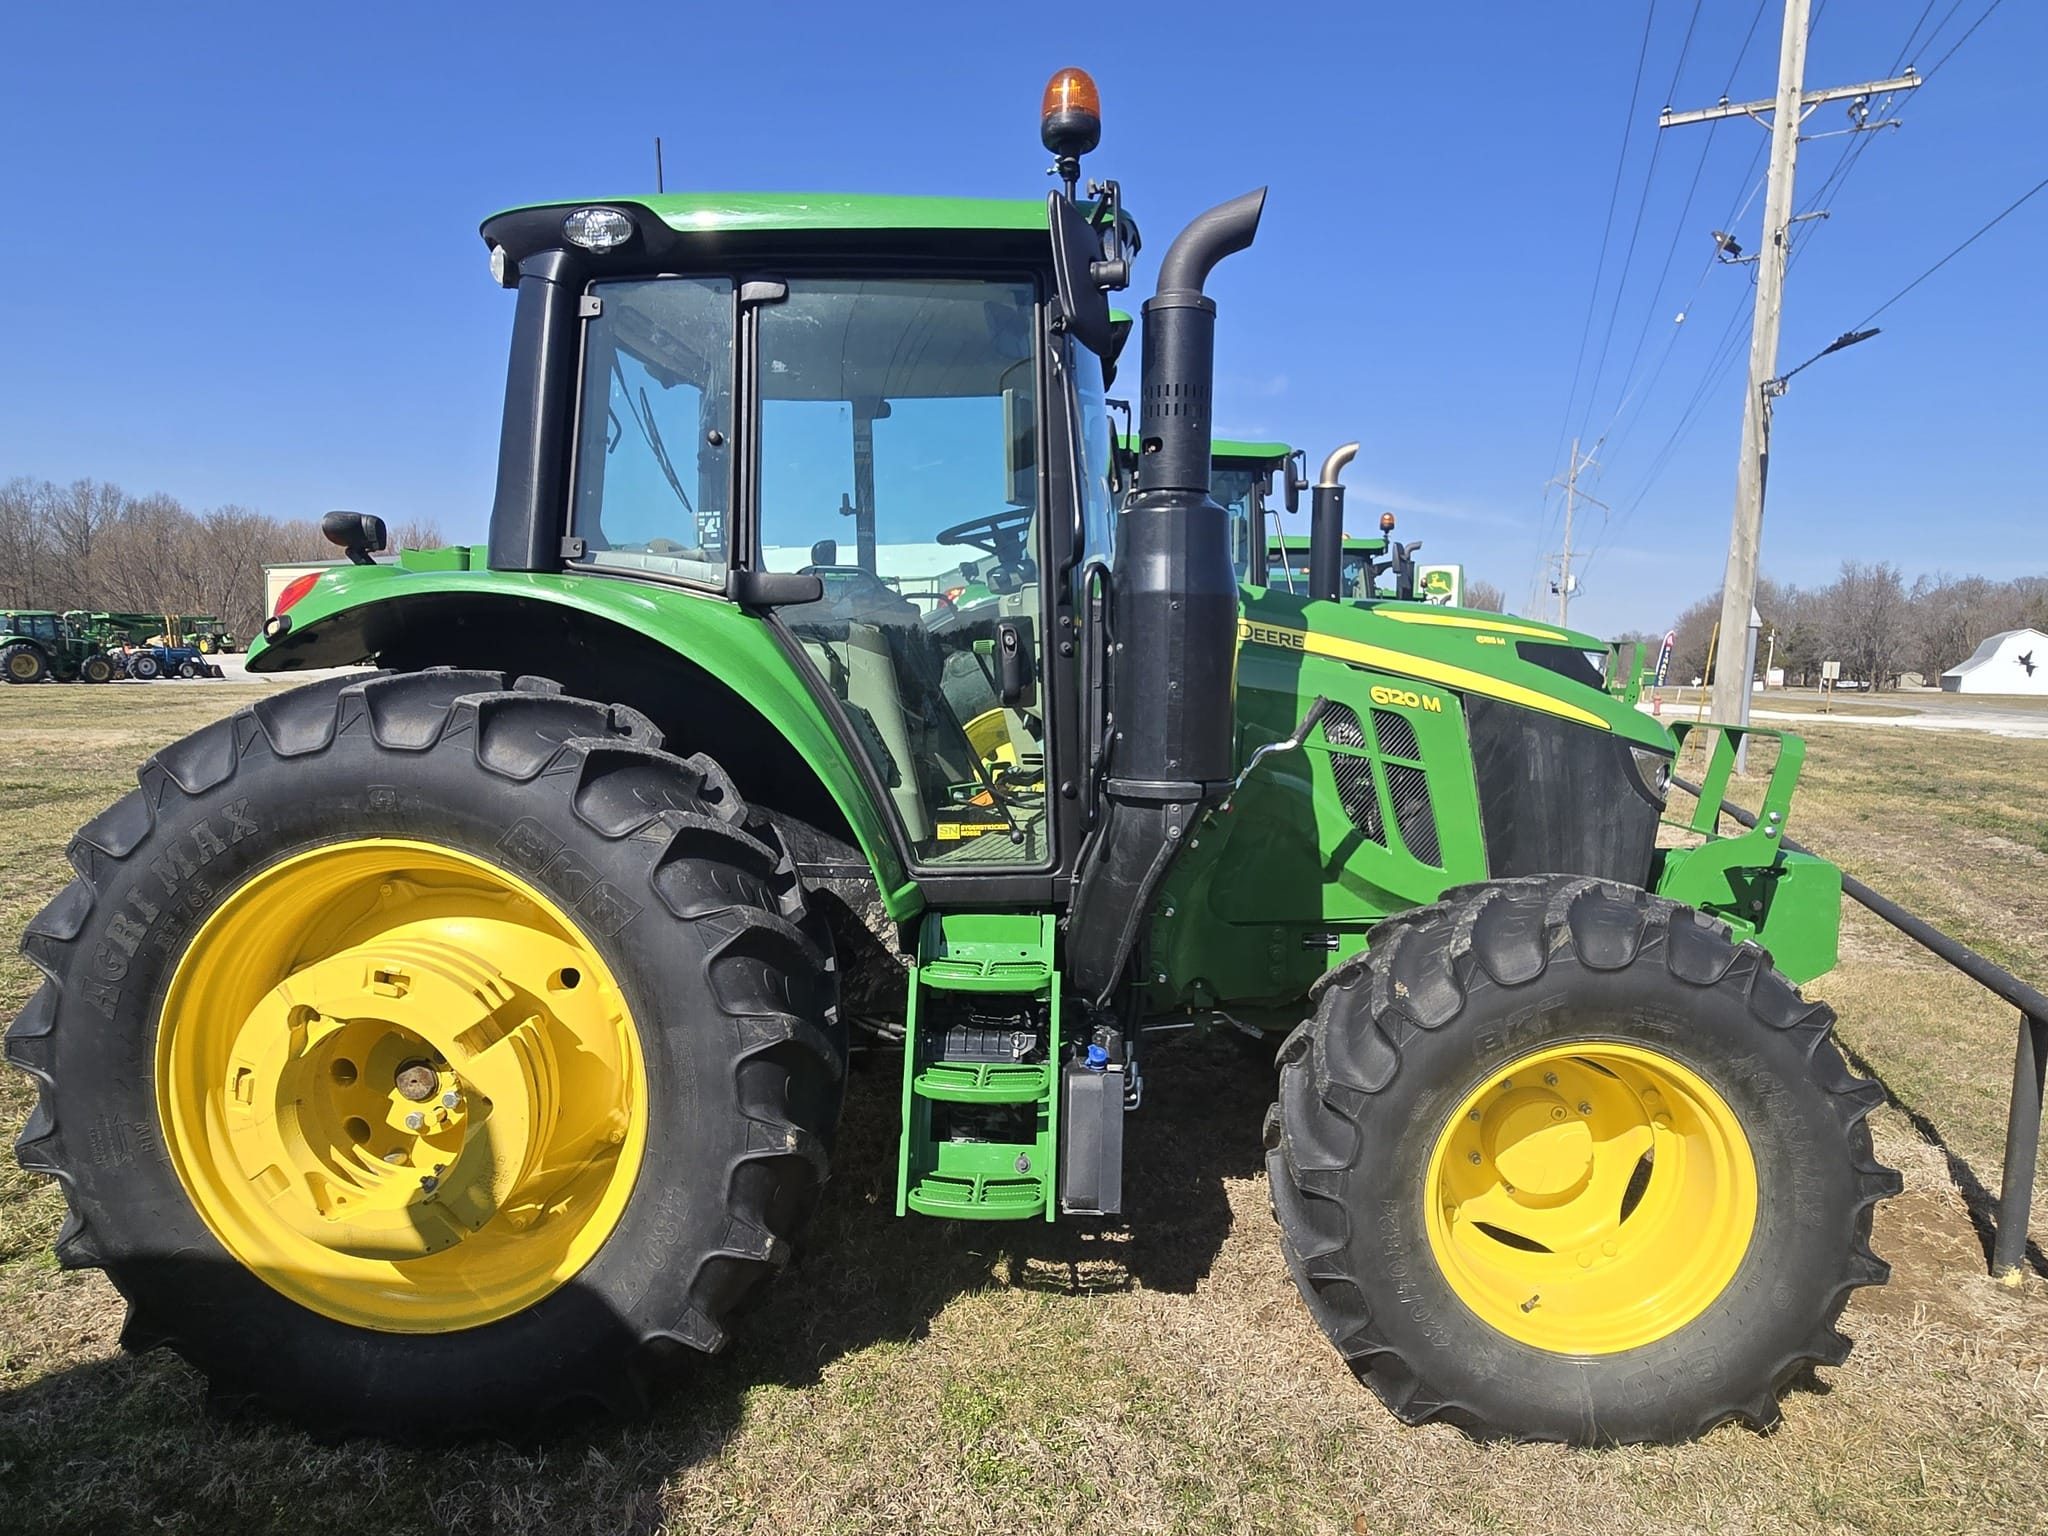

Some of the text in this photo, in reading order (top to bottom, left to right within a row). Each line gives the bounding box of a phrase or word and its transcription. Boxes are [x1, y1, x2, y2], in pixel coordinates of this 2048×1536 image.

[1239, 623, 1304, 648] DEERE
[1370, 685, 1442, 713] 6120 M
[939, 825, 958, 836] SN
